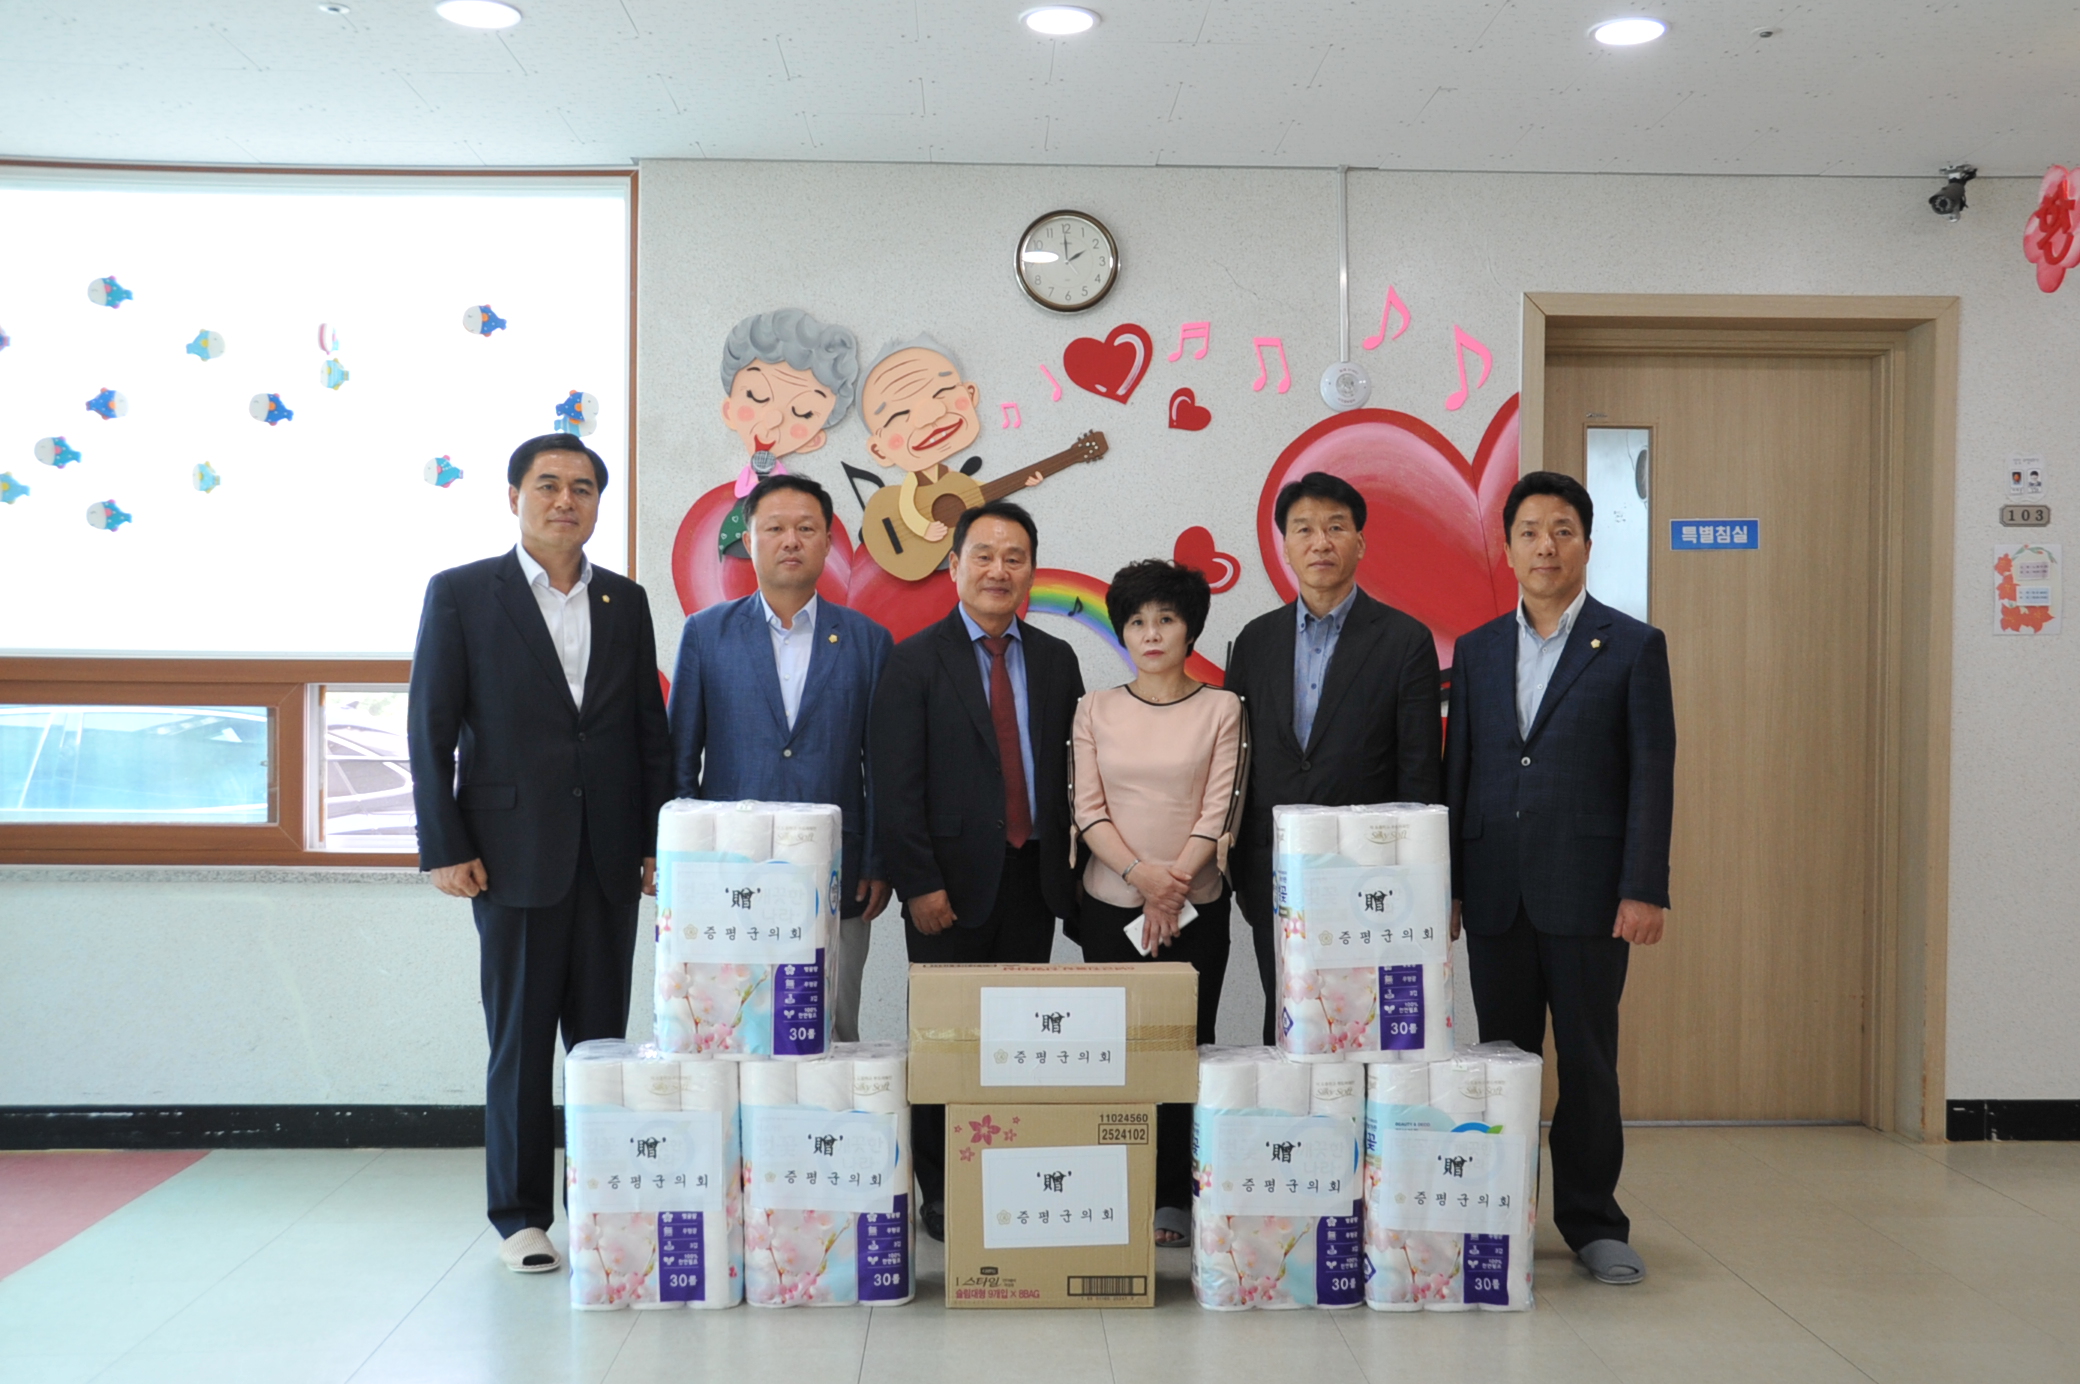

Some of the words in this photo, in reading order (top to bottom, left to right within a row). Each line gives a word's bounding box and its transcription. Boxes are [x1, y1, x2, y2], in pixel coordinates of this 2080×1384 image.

[1047, 228, 1053, 238] 11
[1061, 223, 1071, 234] 12
[1092, 238, 1099, 249] 2
[1099, 256, 1106, 266] 3
[1034, 275, 1041, 285] 8
[1095, 274, 1101, 283] 4
[1048, 287, 1054, 297] 7
[1065, 290, 1071, 301] 6
[1081, 286, 1088, 296] 5
[2007, 509, 2044, 522] 103
[1681, 525, 1749, 544] 특별침실
[1099, 1113, 1148, 1123] 11024560
[1102, 1128, 1146, 1141] 2524102
[962, 1277, 1001, 1287] 스타일
